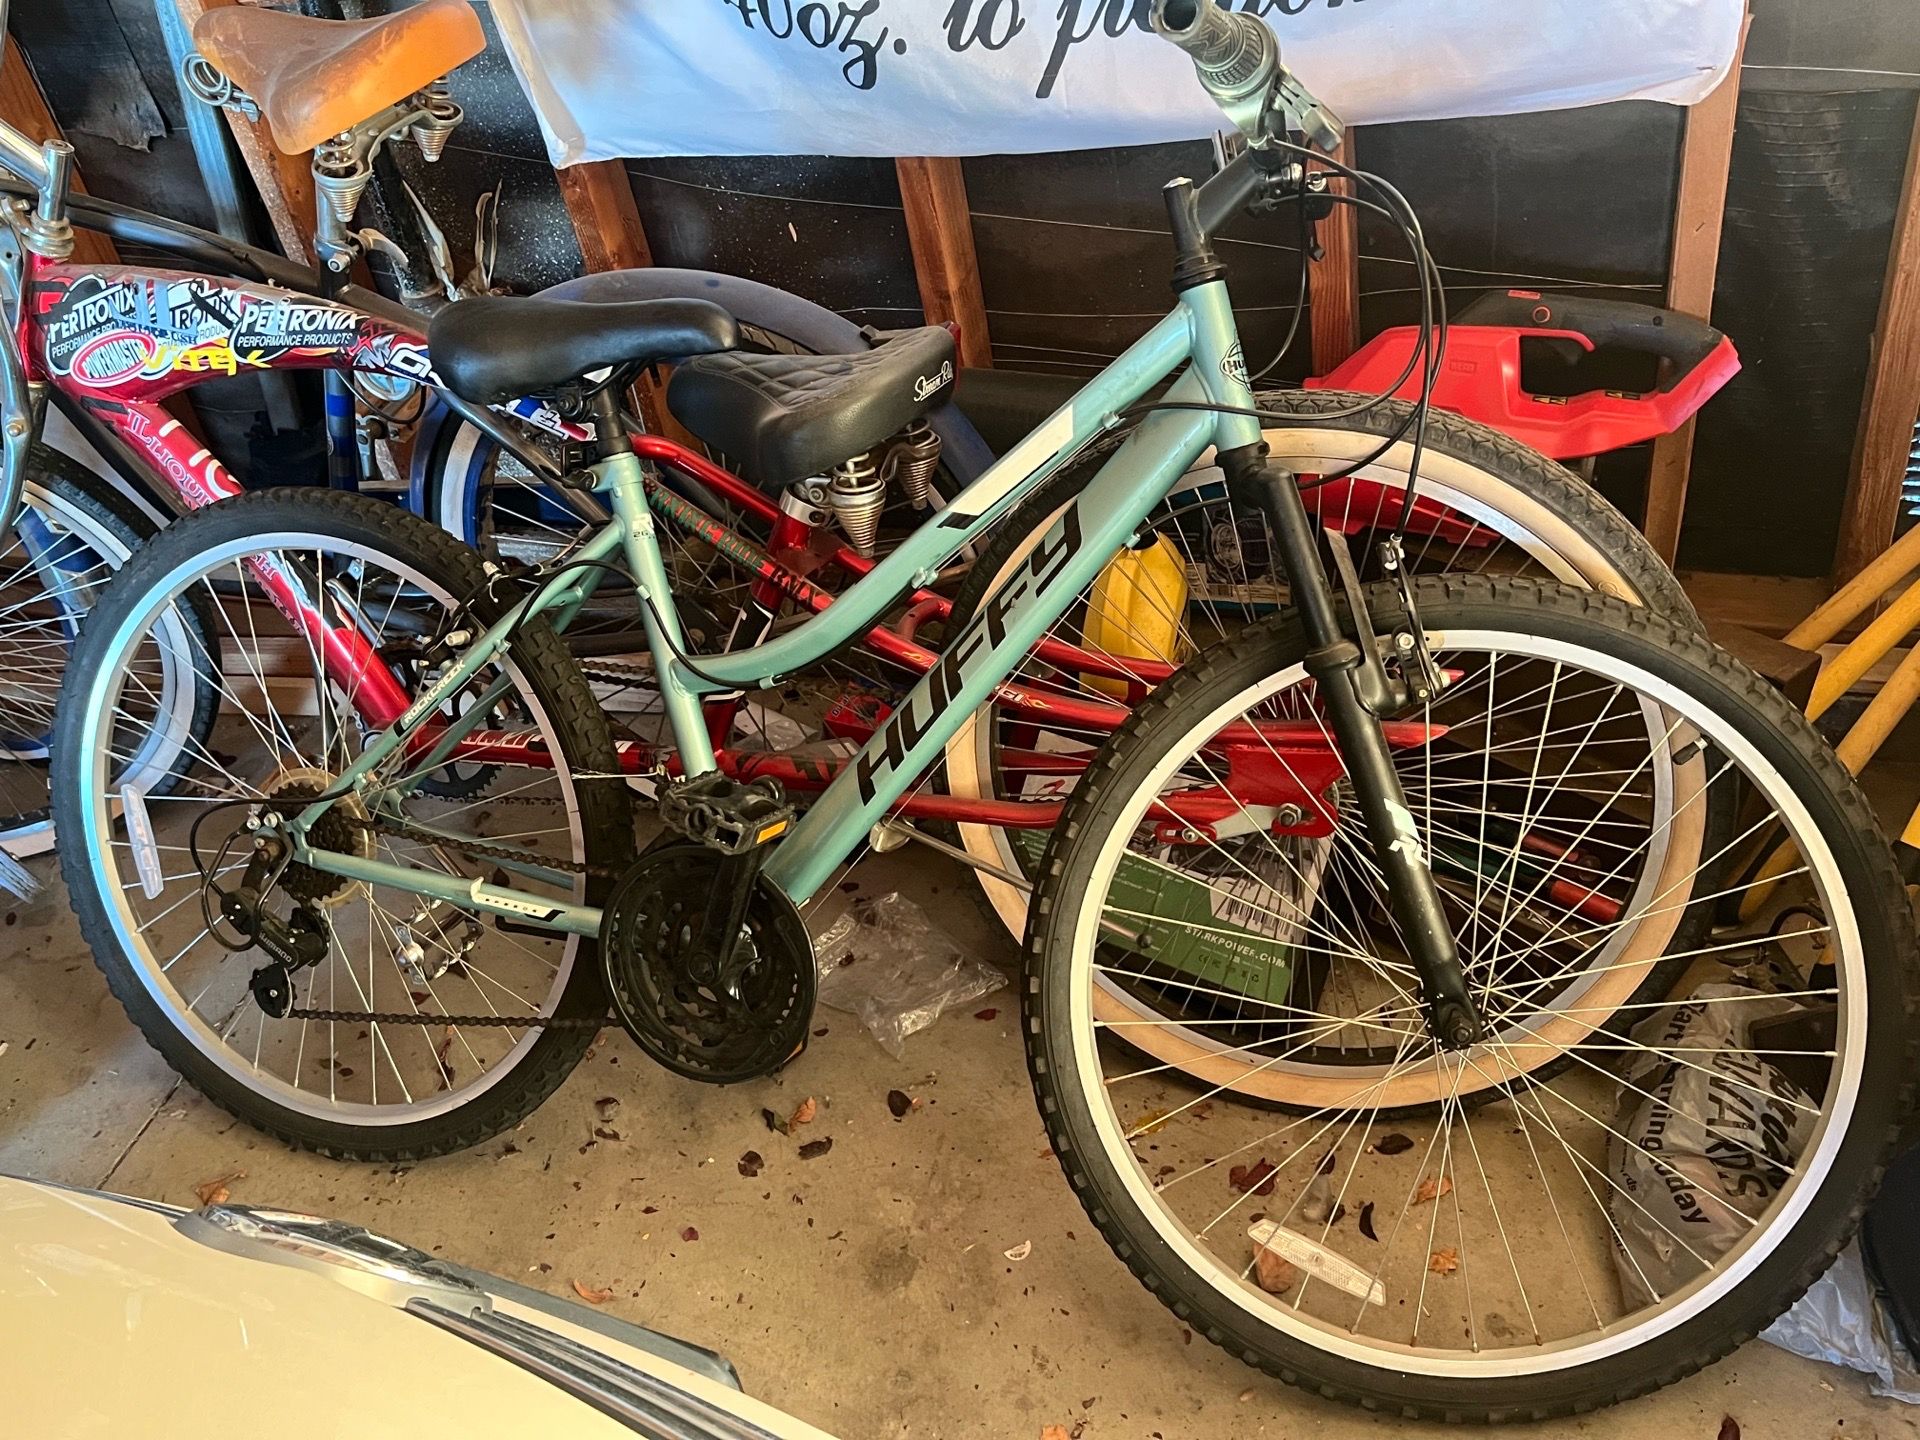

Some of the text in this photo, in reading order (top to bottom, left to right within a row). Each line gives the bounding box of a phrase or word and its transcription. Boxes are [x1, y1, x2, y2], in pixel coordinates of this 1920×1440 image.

[237, 332, 353, 348] PERFORMANCE PRODUCTS
[856, 498, 1082, 807] HUFFY
[1184, 925, 1286, 969] STARKPOWER.COM
